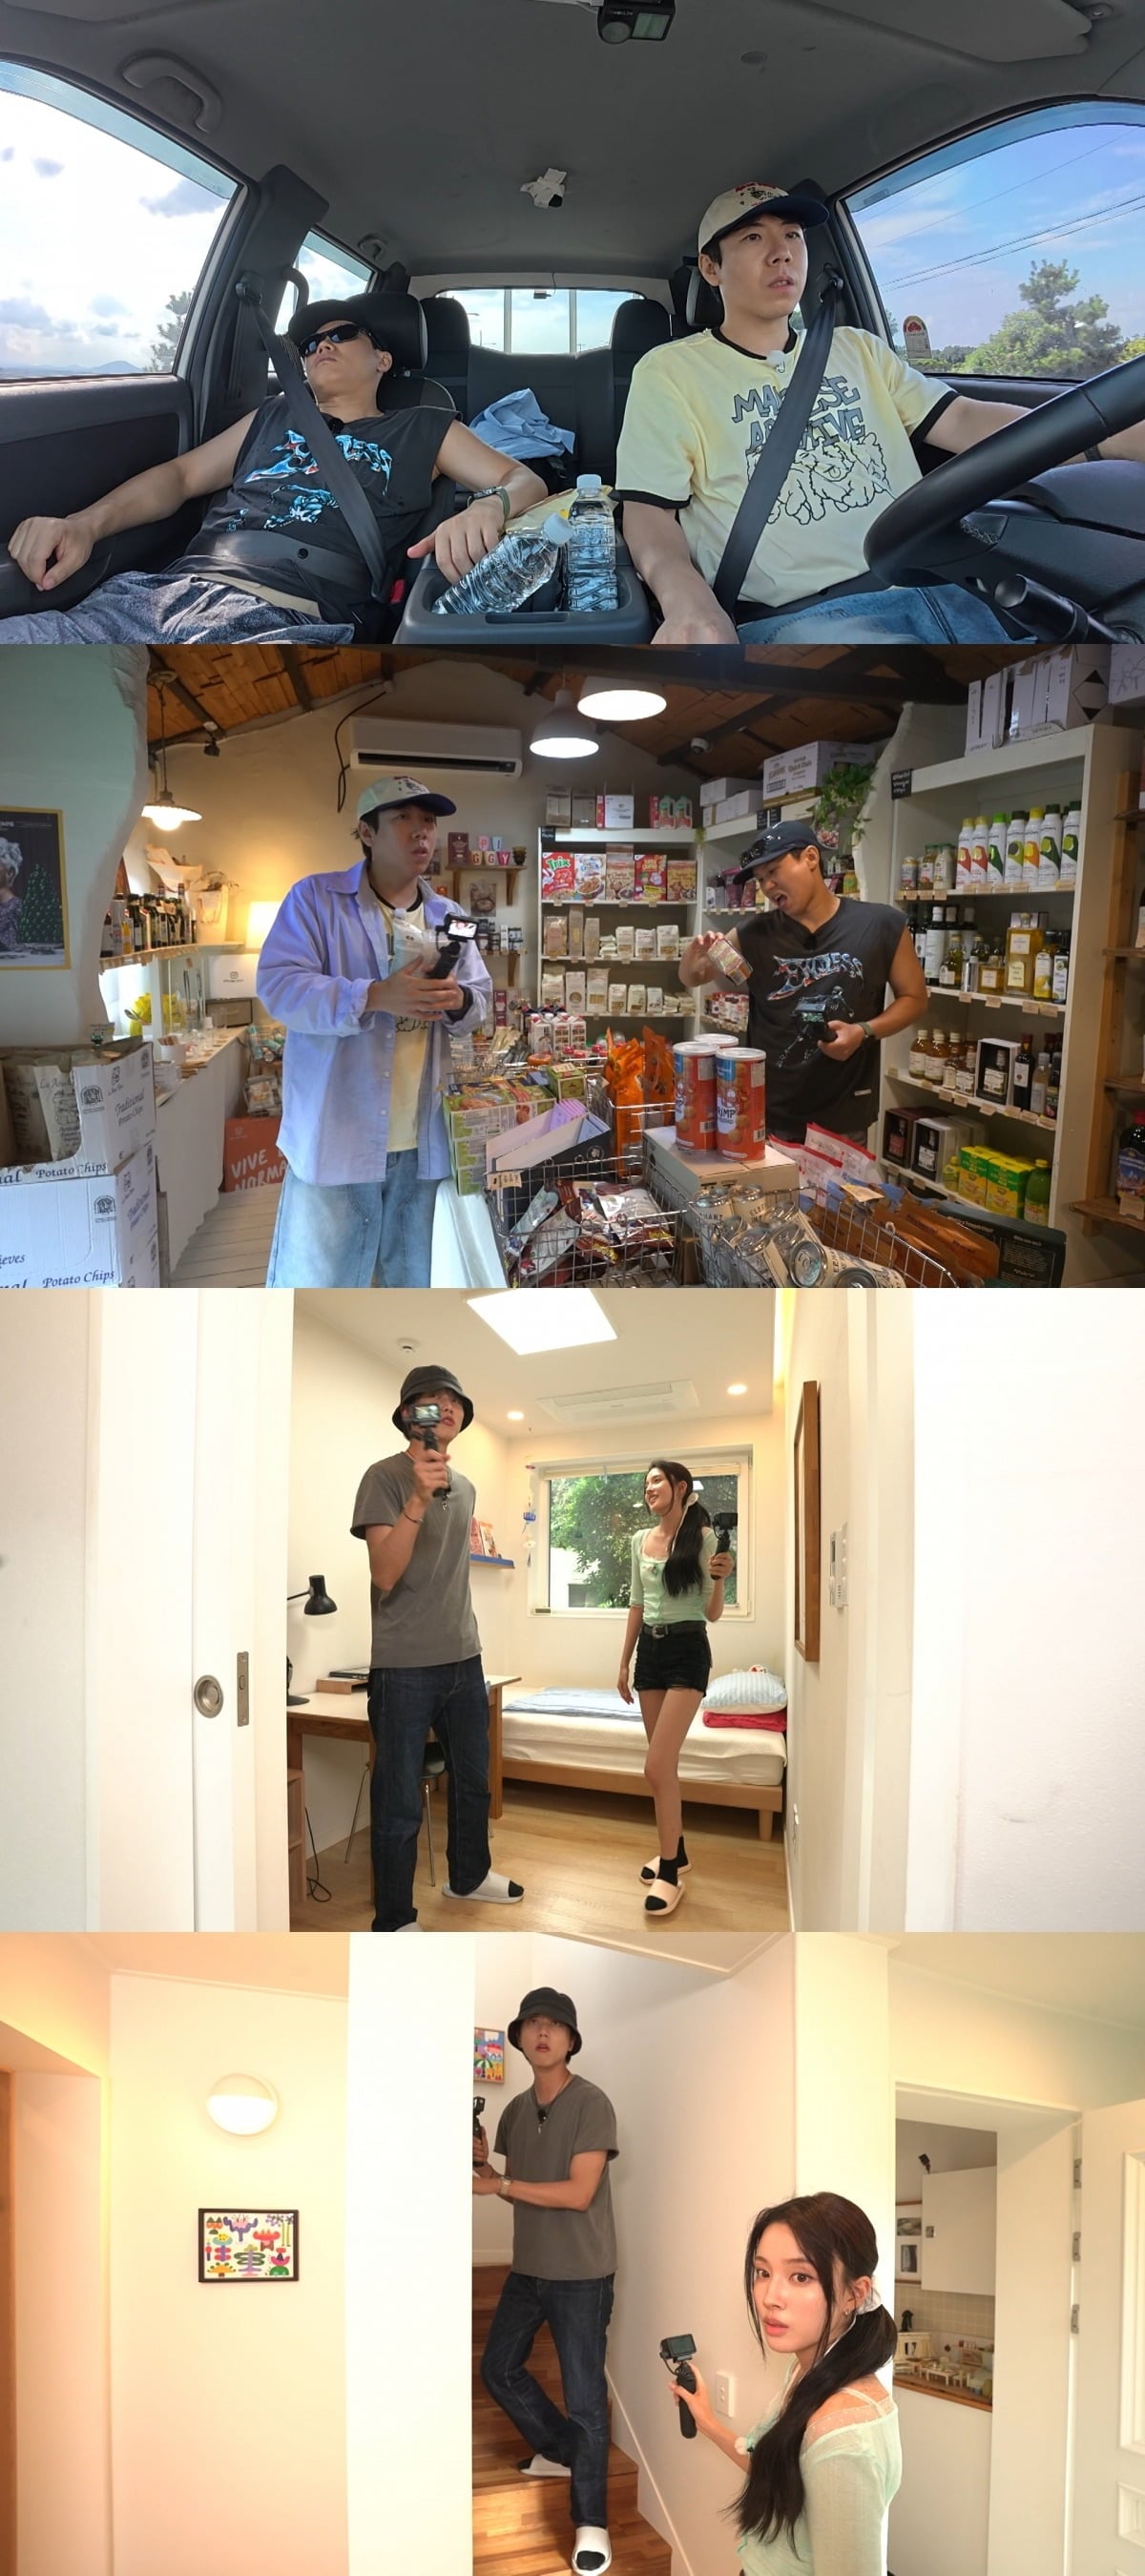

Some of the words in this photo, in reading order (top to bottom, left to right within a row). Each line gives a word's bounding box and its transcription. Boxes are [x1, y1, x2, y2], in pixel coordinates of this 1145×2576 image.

[547, 857, 571, 870] Trix
[35, 1167, 74, 1179] Potato
[76, 1161, 107, 1176] Chips
[231, 1149, 268, 1178] VIVE
[42, 1275, 81, 1288] Potato
[83, 1269, 115, 1284] Chips
